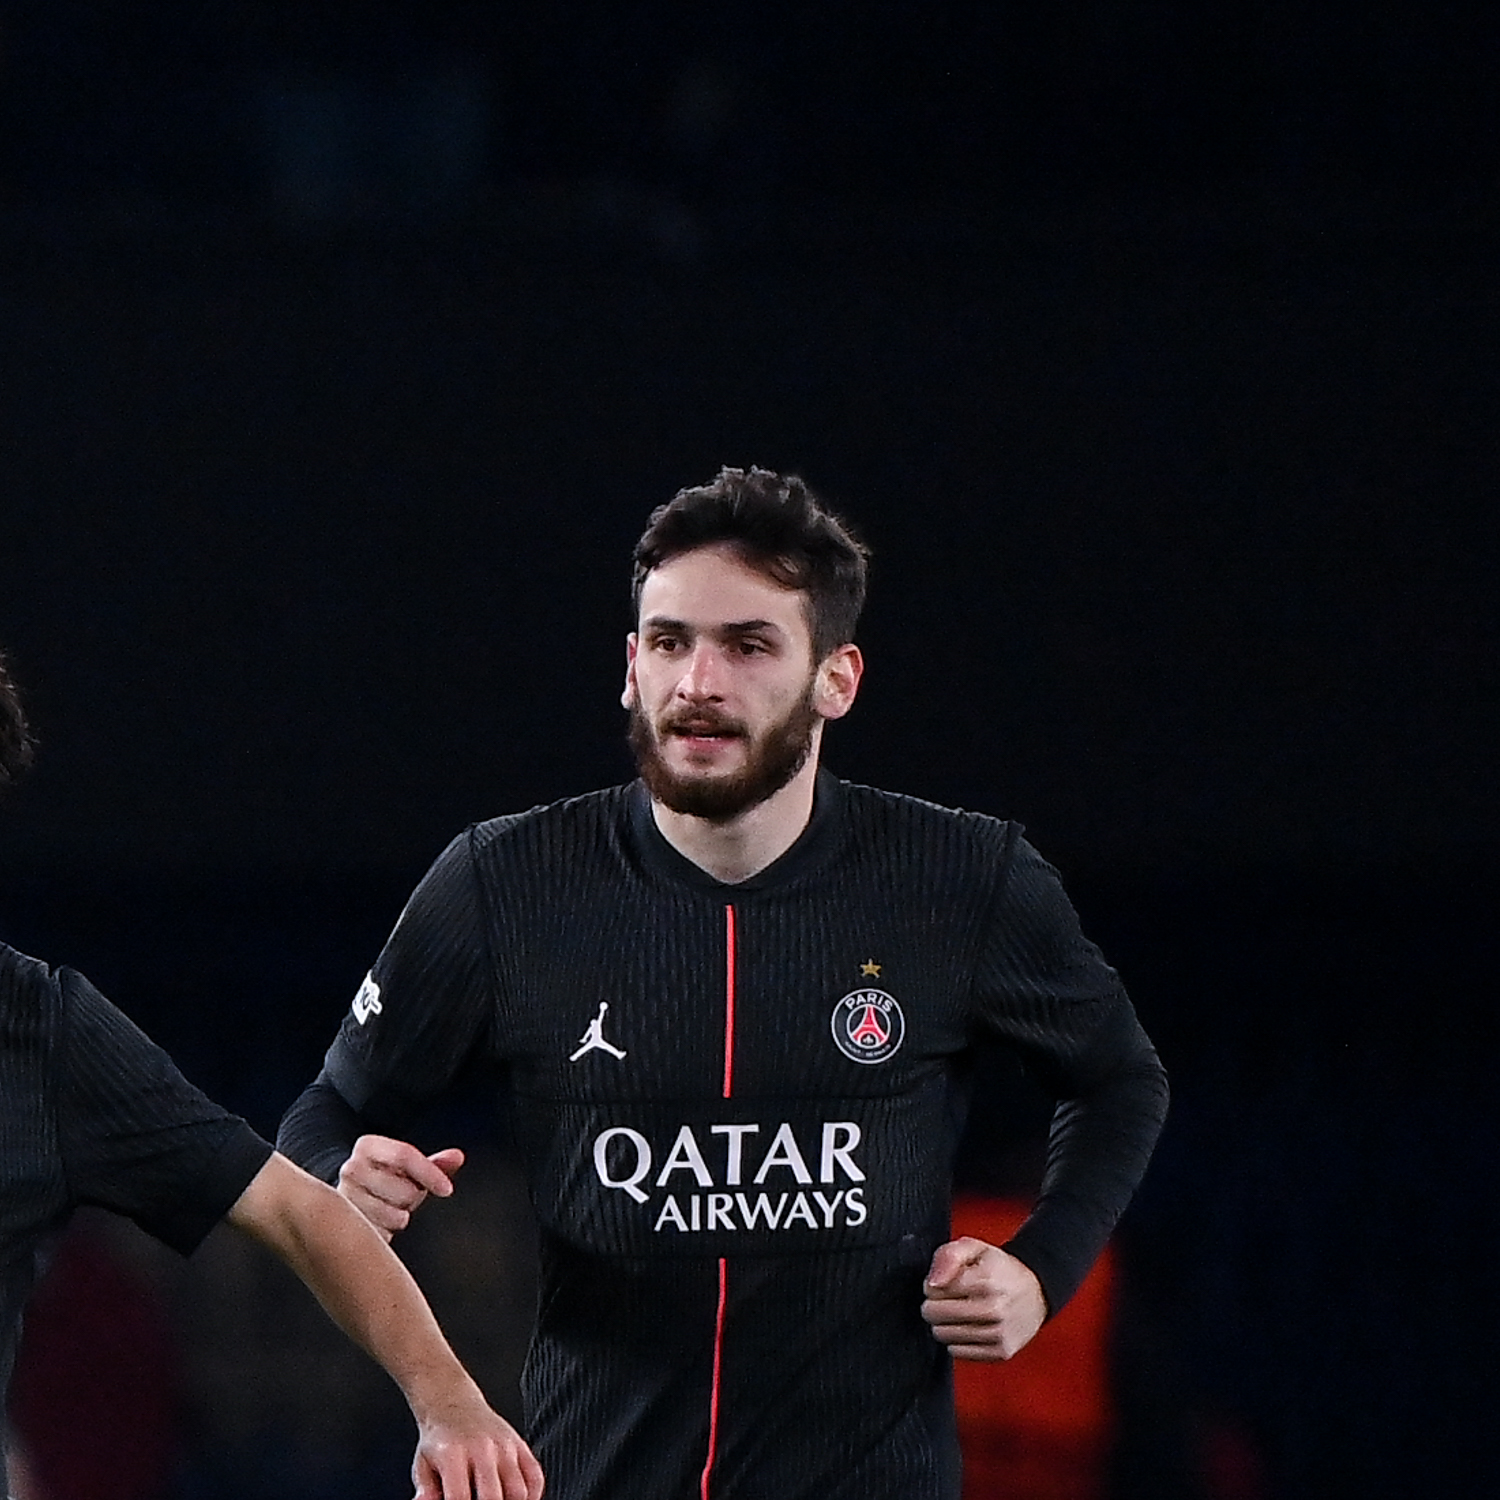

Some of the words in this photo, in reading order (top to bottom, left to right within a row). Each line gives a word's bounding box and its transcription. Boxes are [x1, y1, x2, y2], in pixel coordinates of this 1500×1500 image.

[844, 992, 894, 1012] PARIS
[593, 1122, 867, 1204] QATAR
[654, 1187, 868, 1232] AIRWAYS
